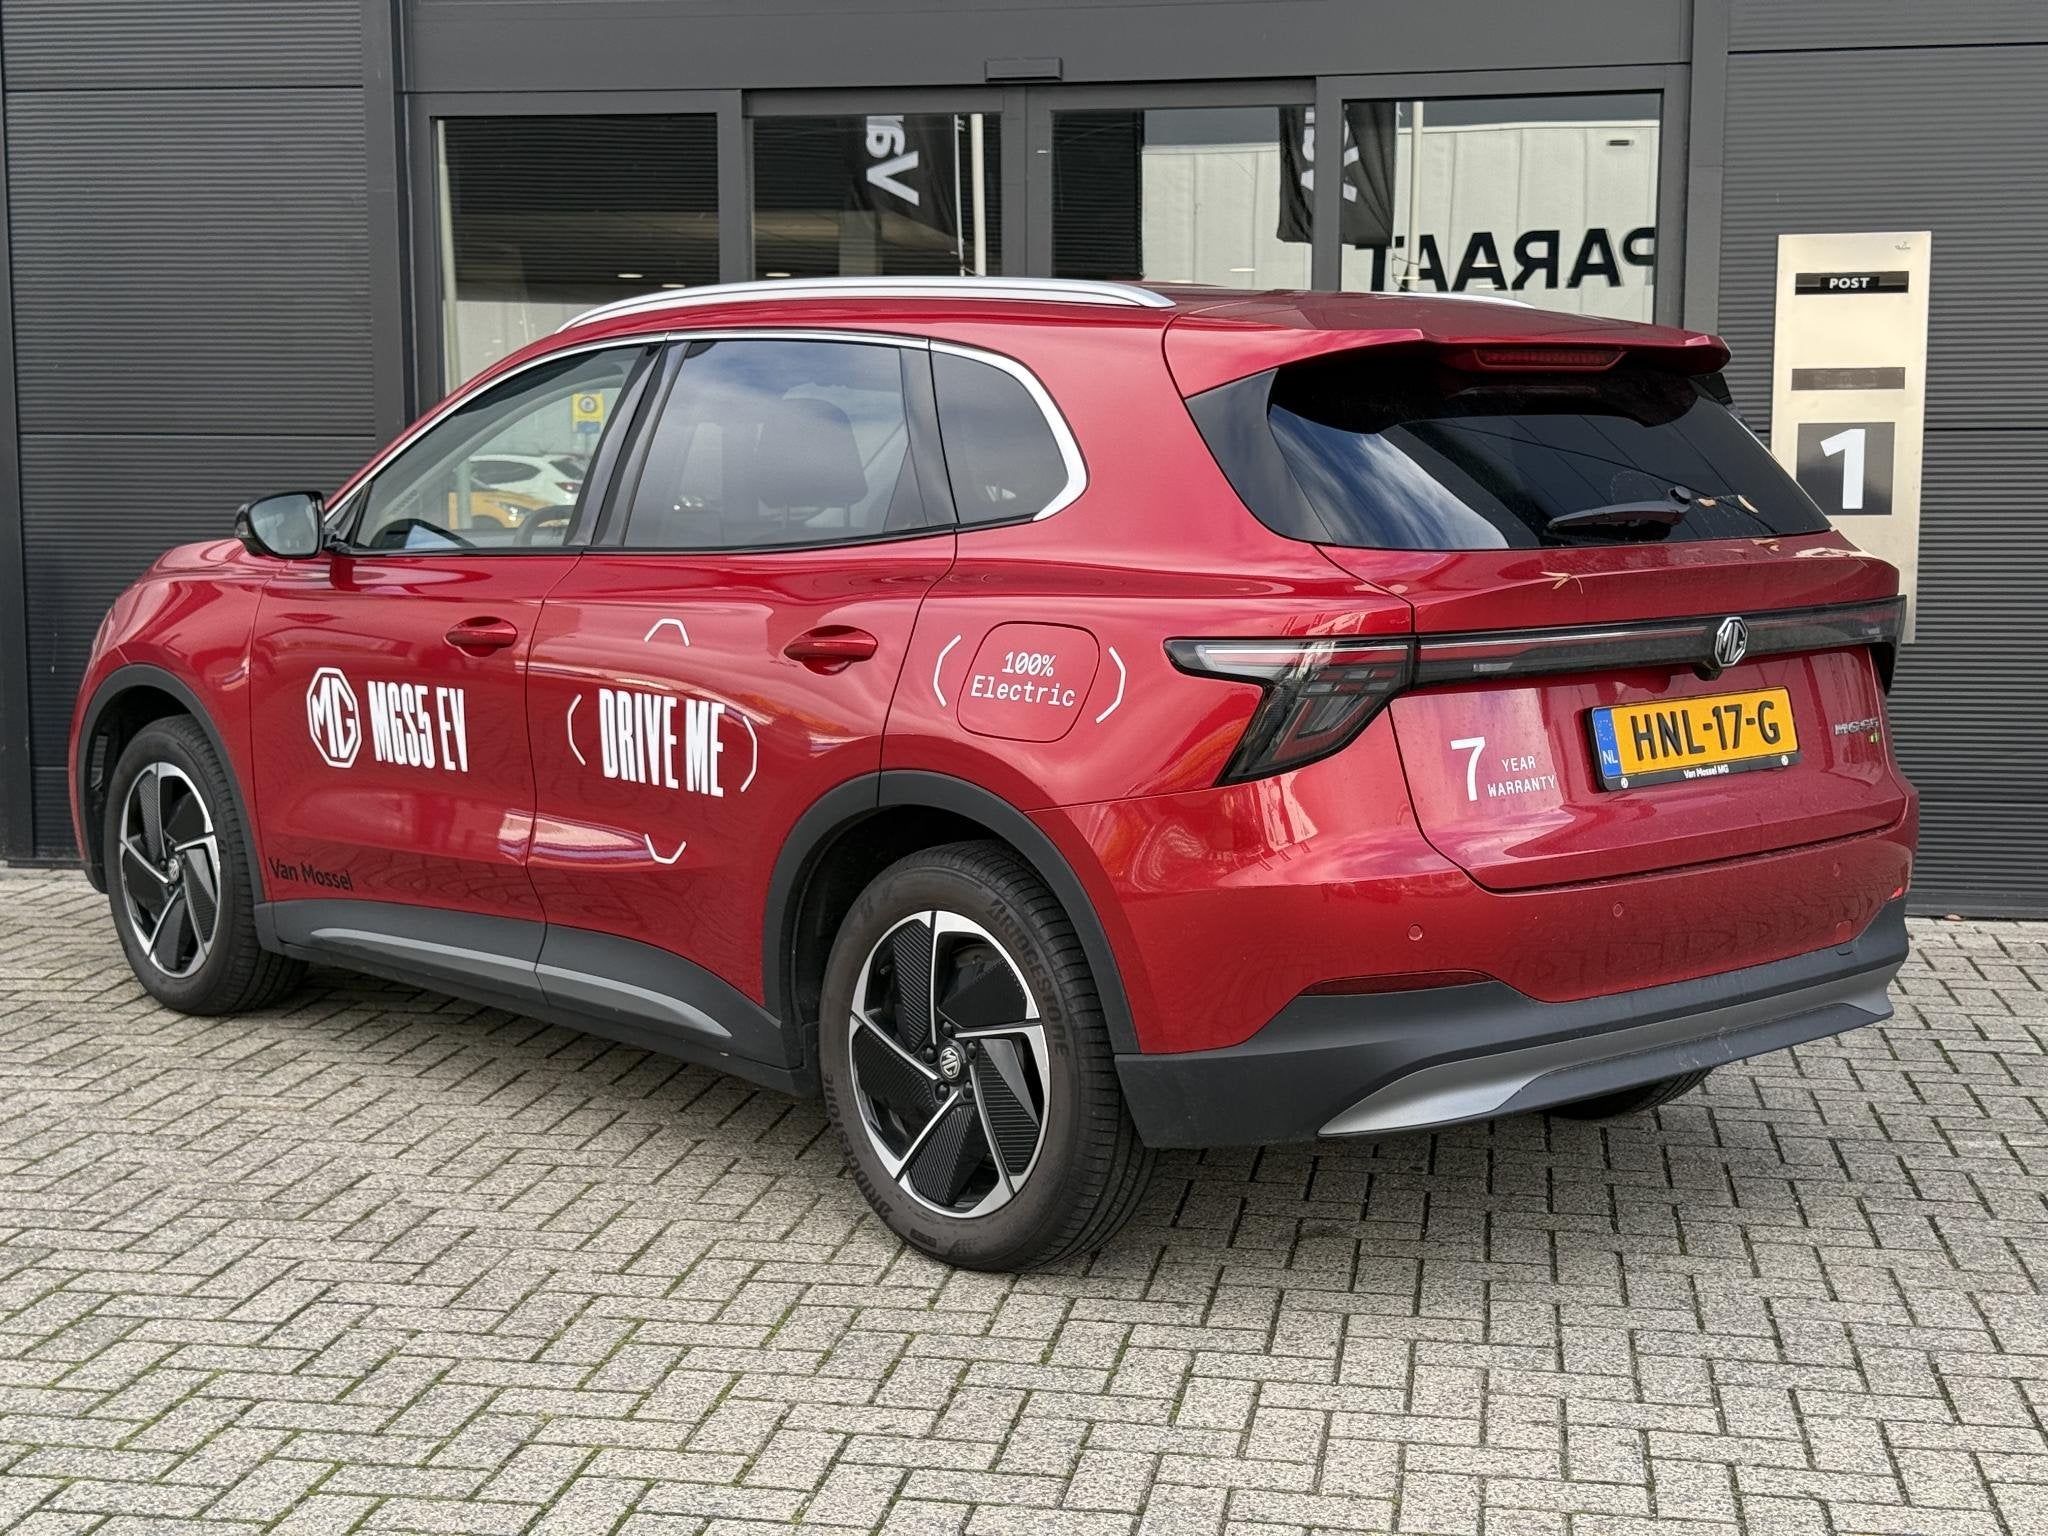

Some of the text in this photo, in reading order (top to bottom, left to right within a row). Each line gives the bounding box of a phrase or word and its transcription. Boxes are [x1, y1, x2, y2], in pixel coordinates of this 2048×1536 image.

[1829, 277, 1870, 289] POST
[1820, 428, 1866, 510] 1
[1718, 622, 1746, 663] MG
[1001, 651, 1057, 677] 100%
[970, 674, 1076, 707] Electric
[311, 676, 469, 772] MG MGS5 EV
[599, 688, 726, 798] DRIVE ME
[1630, 700, 1781, 761] HNL-17-G
[1450, 736, 1536, 802] 7 YEAR
[1602, 750, 1619, 765] NL
[1487, 774, 1556, 797] WARRANTY
[268, 857, 354, 892] Van Mossel
